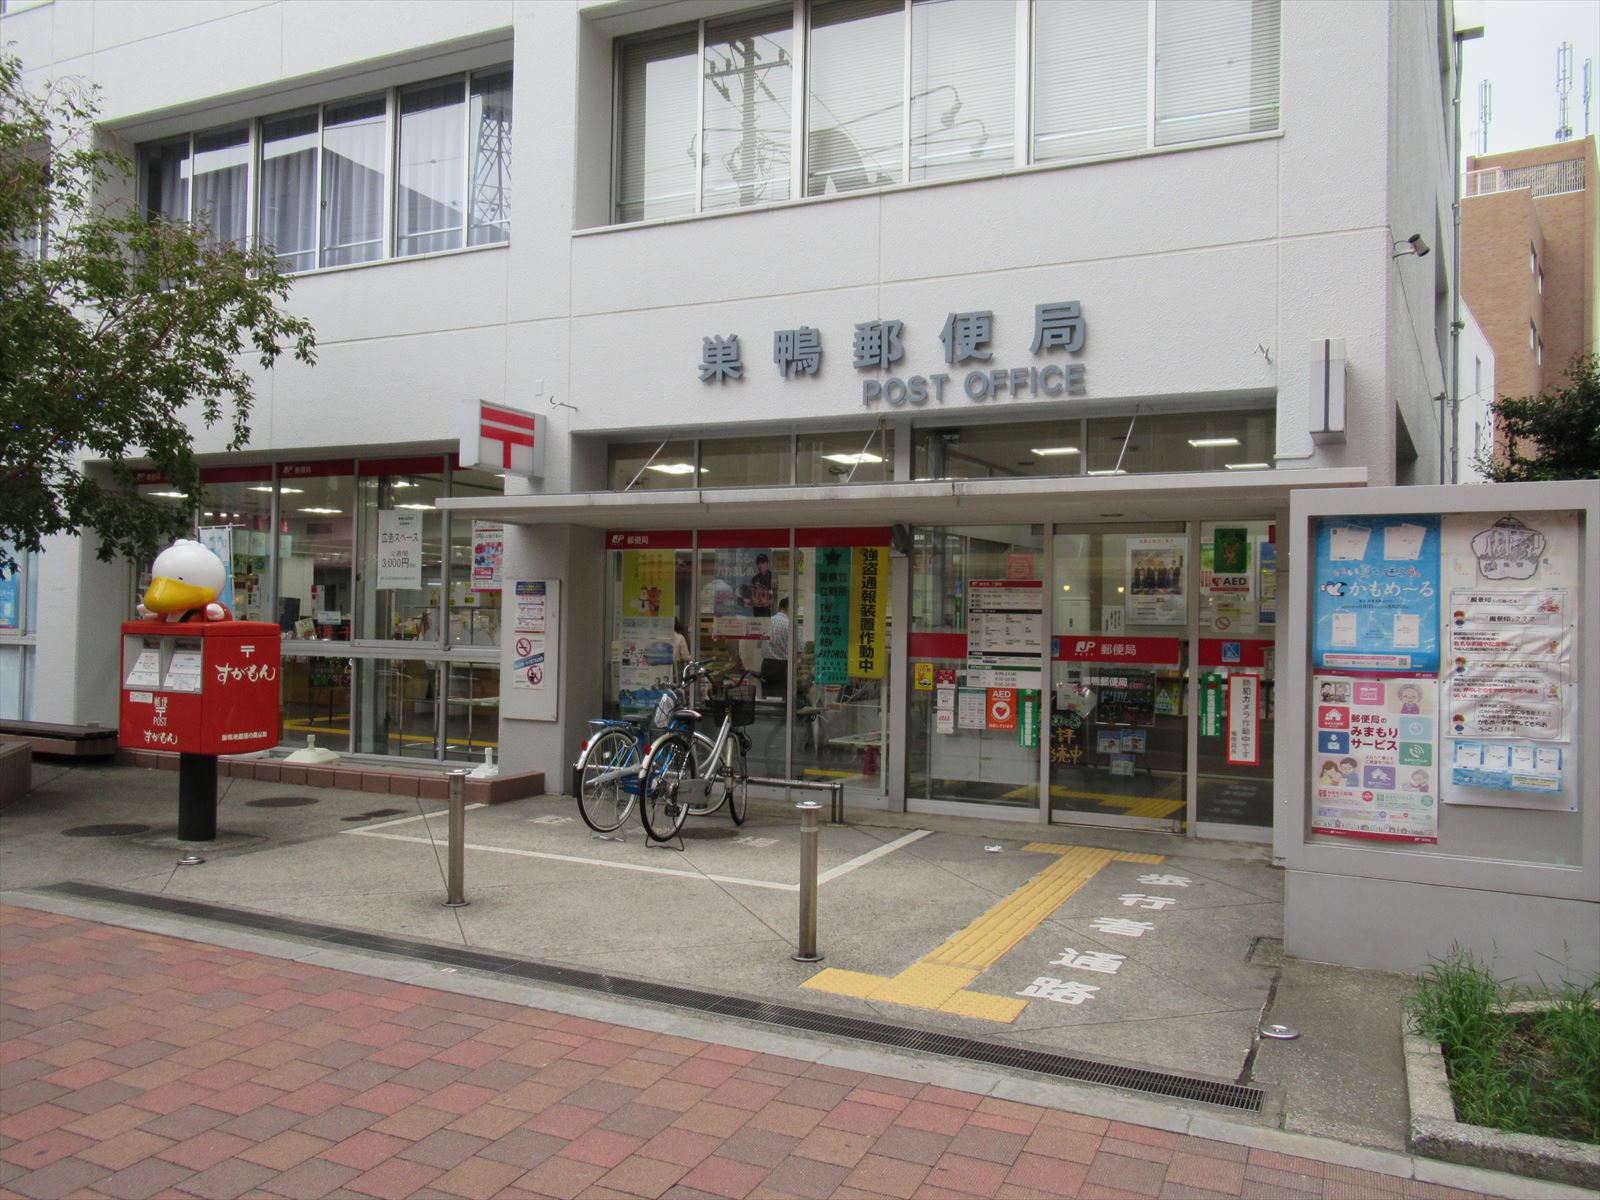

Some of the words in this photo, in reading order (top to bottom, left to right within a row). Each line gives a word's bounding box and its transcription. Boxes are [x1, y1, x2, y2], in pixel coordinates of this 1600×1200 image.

[698, 300, 1087, 383] 巣鴨郵便局
[863, 373, 949, 406] POST
[964, 363, 1087, 400] OFFICE
[381, 532, 419, 543] 広告スペース
[627, 535, 649, 545] 郵便局
[1223, 577, 1247, 586] AED
[858, 548, 878, 673] 強盗通報装置作動中
[1075, 641, 1096, 653] JP
[1101, 643, 1137, 656] 郵便局
[214, 663, 276, 685] すがもん
[992, 690, 1011, 698] AED
[153, 717, 167, 726] POST
[1351, 714, 1387, 724] 郵便局の
[143, 729, 178, 745] すがもん
[1350, 726, 1398, 738] みまもり
[1350, 738, 1398, 751] サービス
[1015, 873, 1193, 1005] 歩行者通路
